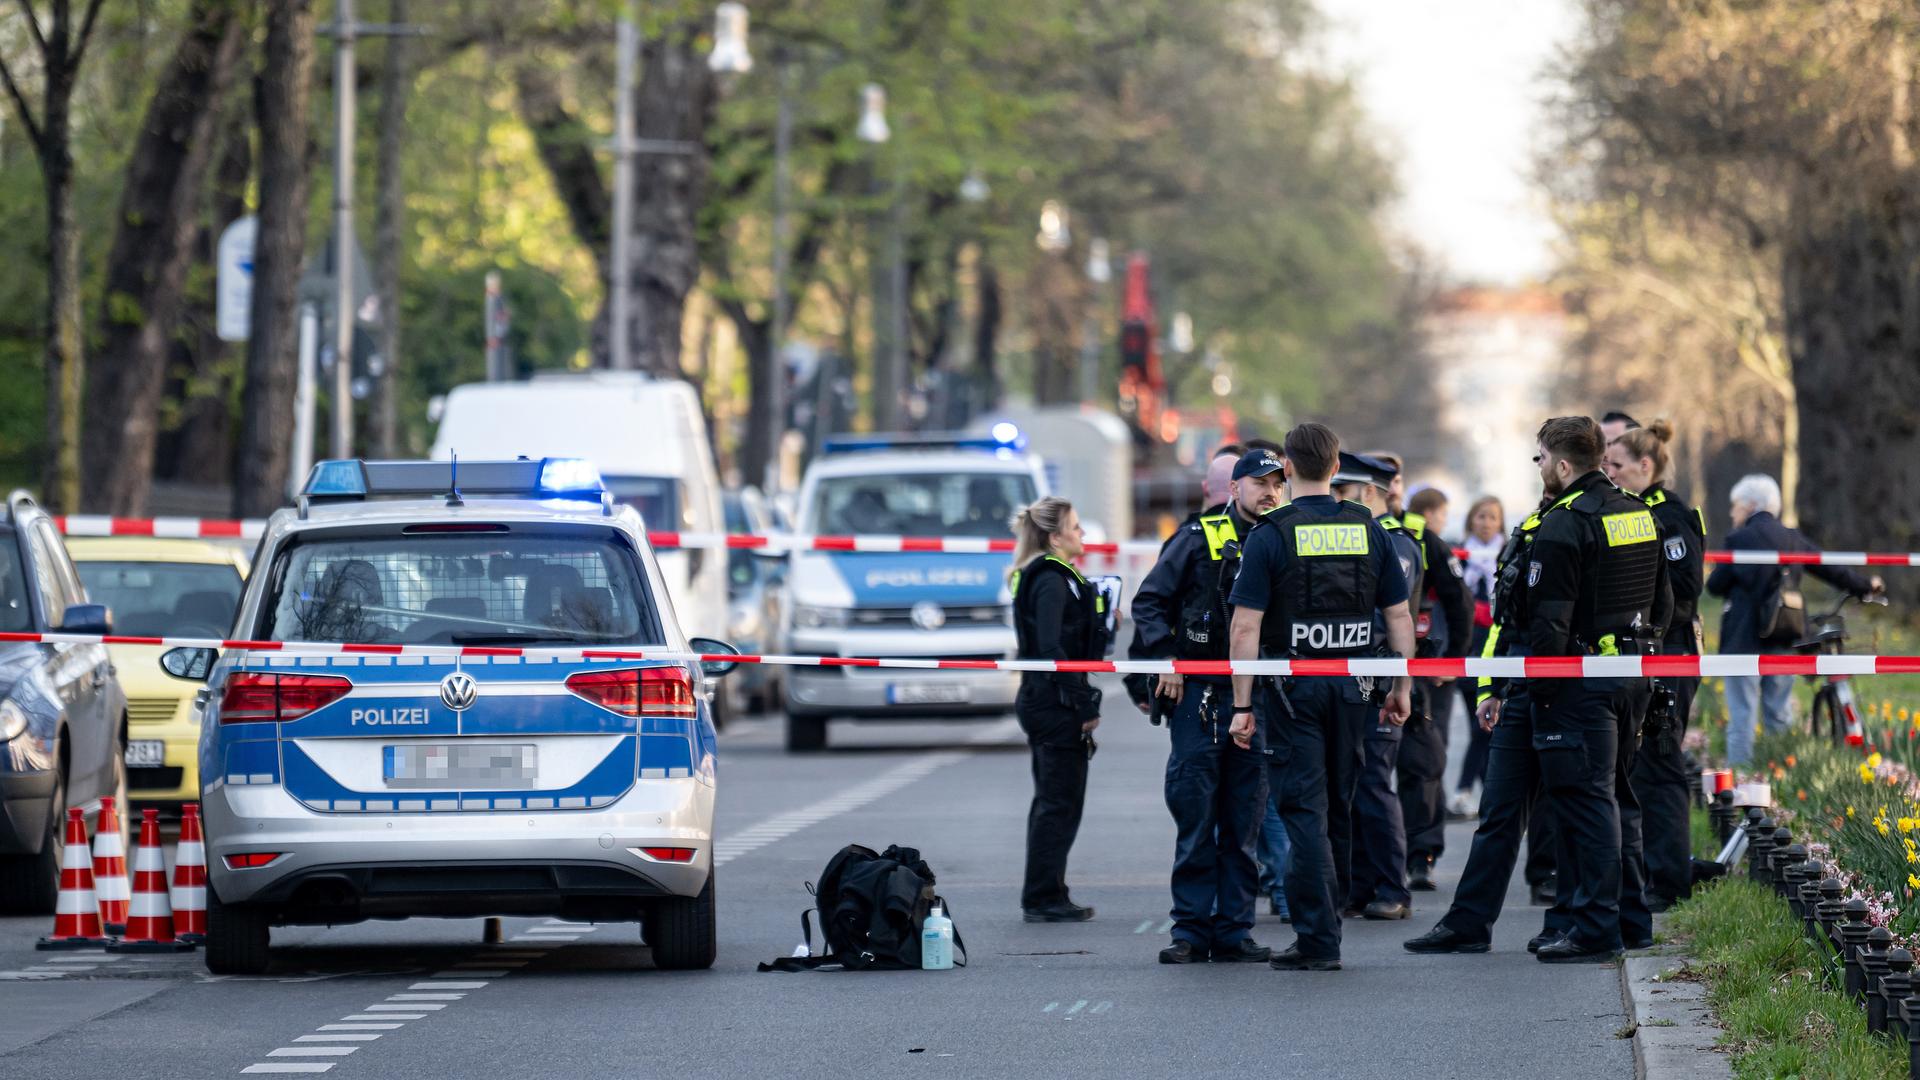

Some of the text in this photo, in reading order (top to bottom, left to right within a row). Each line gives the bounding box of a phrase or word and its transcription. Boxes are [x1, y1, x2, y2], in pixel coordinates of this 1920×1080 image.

[1297, 527, 1366, 553] POLIZEI
[1607, 516, 1654, 542] POLIZEI
[866, 568, 988, 588] POLIZEI
[1186, 628, 1208, 643] POLIZEI
[1291, 622, 1371, 649] POLIZEI
[351, 708, 429, 726] POLIZEI
